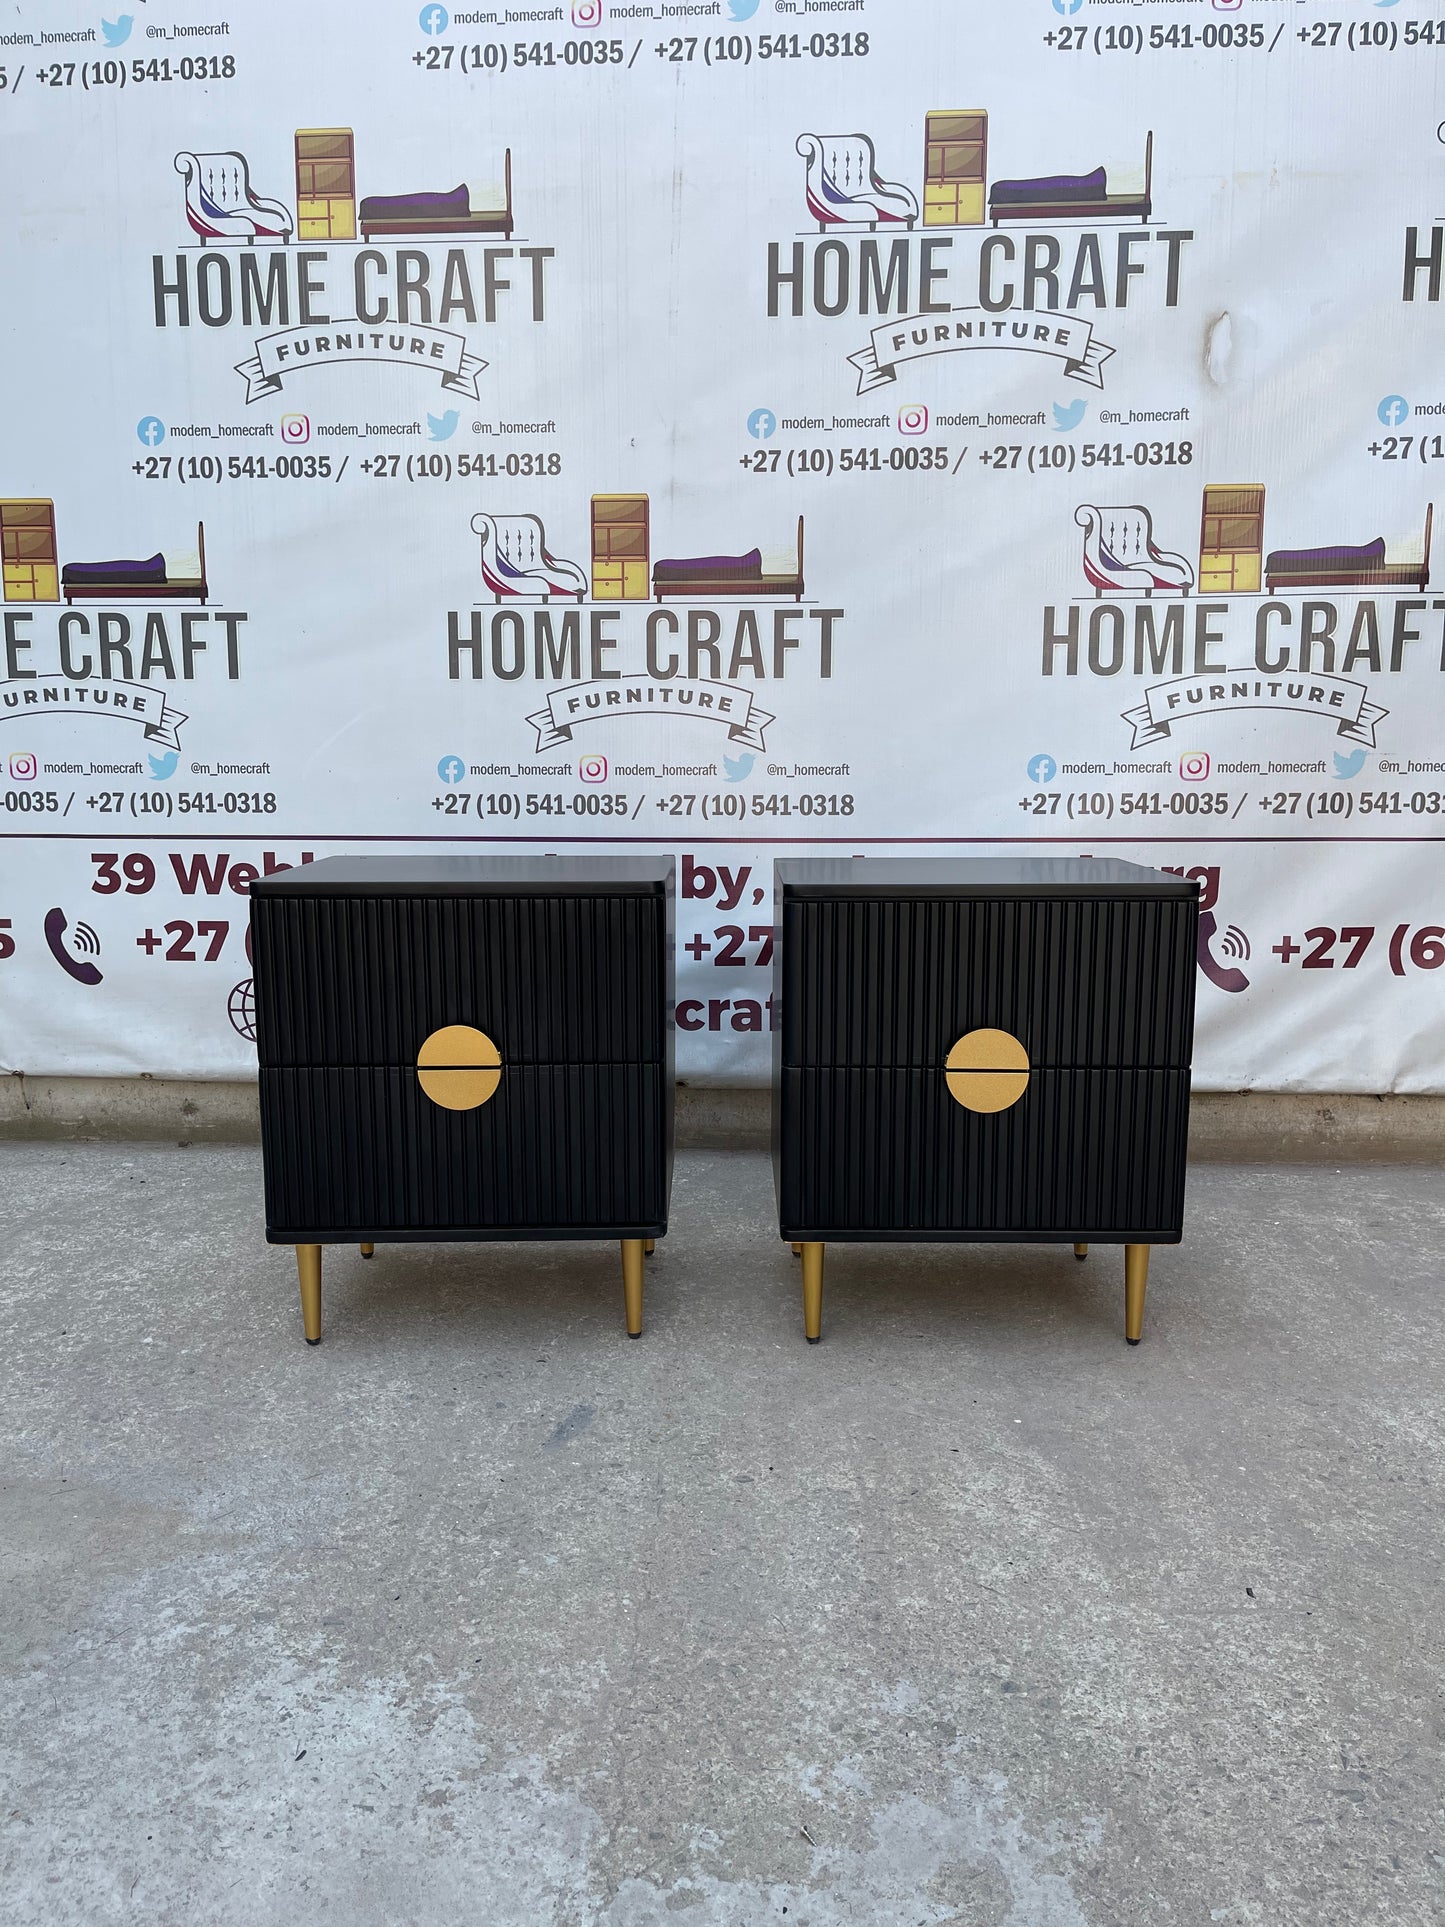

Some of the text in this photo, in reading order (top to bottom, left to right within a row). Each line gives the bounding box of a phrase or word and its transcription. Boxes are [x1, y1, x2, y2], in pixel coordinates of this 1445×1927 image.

[146, 22, 229, 39] @m_homecraft
[1043, 26, 1088, 50] +27
[1094, 25, 1143, 55] (10)
[1149, 24, 1264, 48] 541-0035
[1297, 22, 1342, 46] +27
[1348, 22, 1397, 51] (10)
[412, 46, 454, 69] +27
[461, 44, 507, 74] (10)
[514, 40, 623, 66] 541-0035
[655, 38, 697, 61] +27
[704, 36, 751, 66] (10)
[758, 32, 869, 59] 541-0318
[36, 63, 75, 86] +27
[82, 61, 126, 90] (10)
[132, 55, 235, 82] 541-0318
[153, 248, 554, 327] HOME CRAFT
[768, 230, 1194, 319] HOME CRAFT
[274, 331, 448, 364] FURNITURE
[891, 320, 1070, 353] FURNITURE
[472, 420, 556, 436] @m_homecraft
[1100, 408, 1189, 425] @m_homecraft
[740, 450, 781, 472] +27
[787, 449, 833, 477] (10)
[840, 447, 948, 471] 541-0035
[979, 446, 1022, 469] +27
[1028, 445, 1075, 473] (10)
[1082, 441, 1192, 467] 541-0318
[1368, 437, 1413, 460] +27
[132, 457, 171, 478] +27
[178, 457, 222, 483] (10)
[228, 456, 331, 478] 541-0035
[361, 455, 400, 477] +27
[407, 455, 451, 482] (10)
[458, 453, 561, 476] 541-0318
[57, 612, 247, 680] CRAFT
[448, 609, 844, 682] HOME CRAFT
[1042, 604, 1228, 678] HOME
[565, 686, 732, 715] FURNITURE
[1165, 680, 1345, 712] FURNITURE
[191, 762, 270, 776] @m_homecraft
[767, 764, 850, 777] @m_homecraft
[86, 792, 124, 812] +27
[131, 792, 172, 817] (10)
[178, 792, 276, 813] 541-0318
[432, 794, 470, 814] +27
[477, 794, 520, 819] (10)
[526, 794, 627, 815] 541-0035
[656, 795, 696, 815] +27
[702, 795, 745, 820] (10)
[752, 794, 854, 816] 541-0318
[1019, 793, 1061, 814] +27
[1067, 793, 1114, 819] (10)
[1120, 793, 1228, 814] 541-0035
[1259, 793, 1301, 814] +27
[1307, 792, 1353, 819] (10)
[91, 853, 155, 894] 39
[137, 920, 230, 961] +27
[1272, 926, 1375, 968] +27
